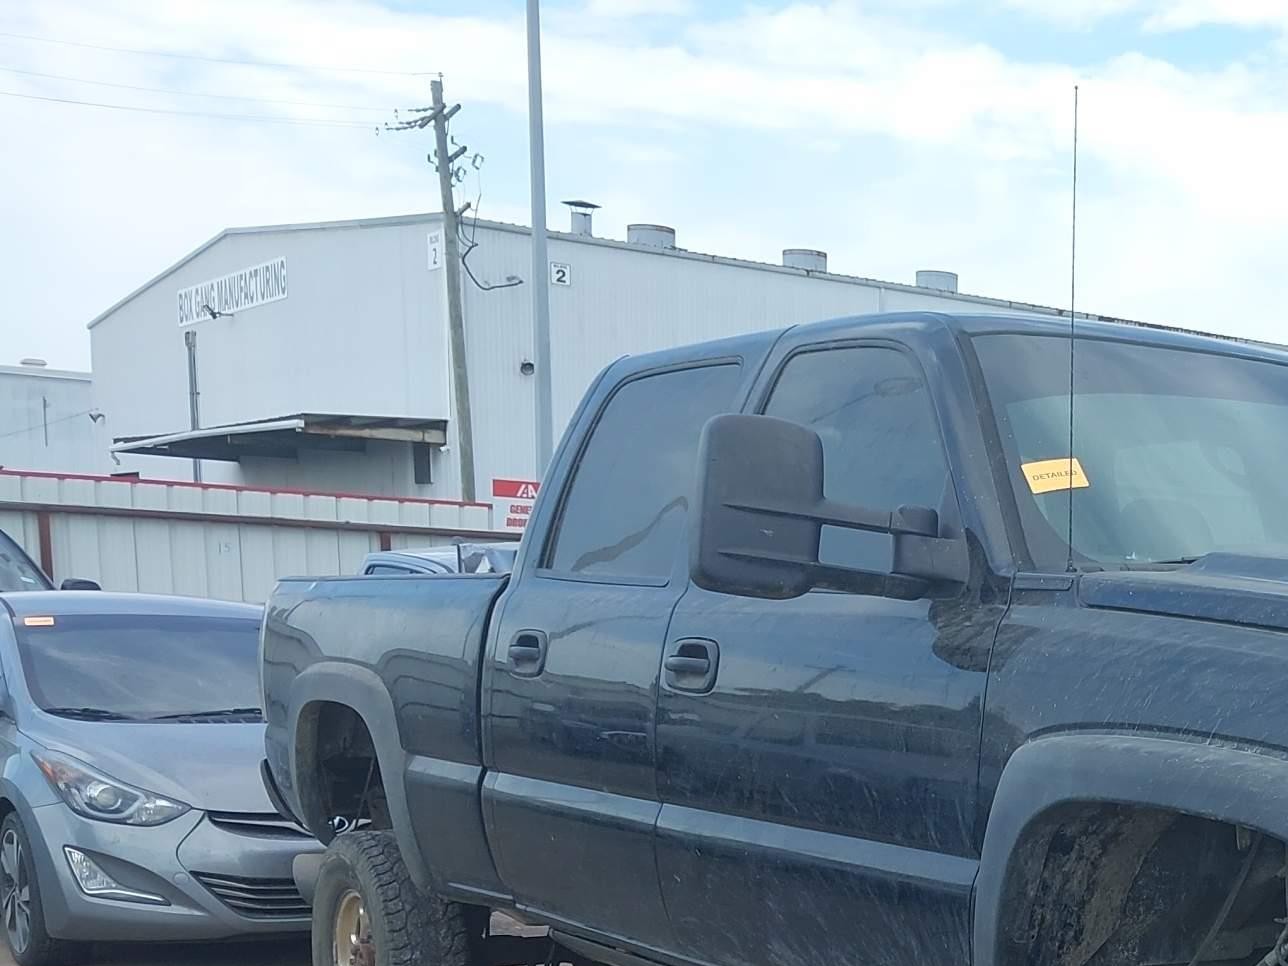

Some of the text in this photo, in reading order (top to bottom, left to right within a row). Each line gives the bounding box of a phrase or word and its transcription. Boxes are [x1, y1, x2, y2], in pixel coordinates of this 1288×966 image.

[556, 269, 566, 284] 2
[179, 289, 194, 324] BOX
[216, 260, 286, 313] MANUFACTURING
[1032, 470, 1078, 481] DETAILED
